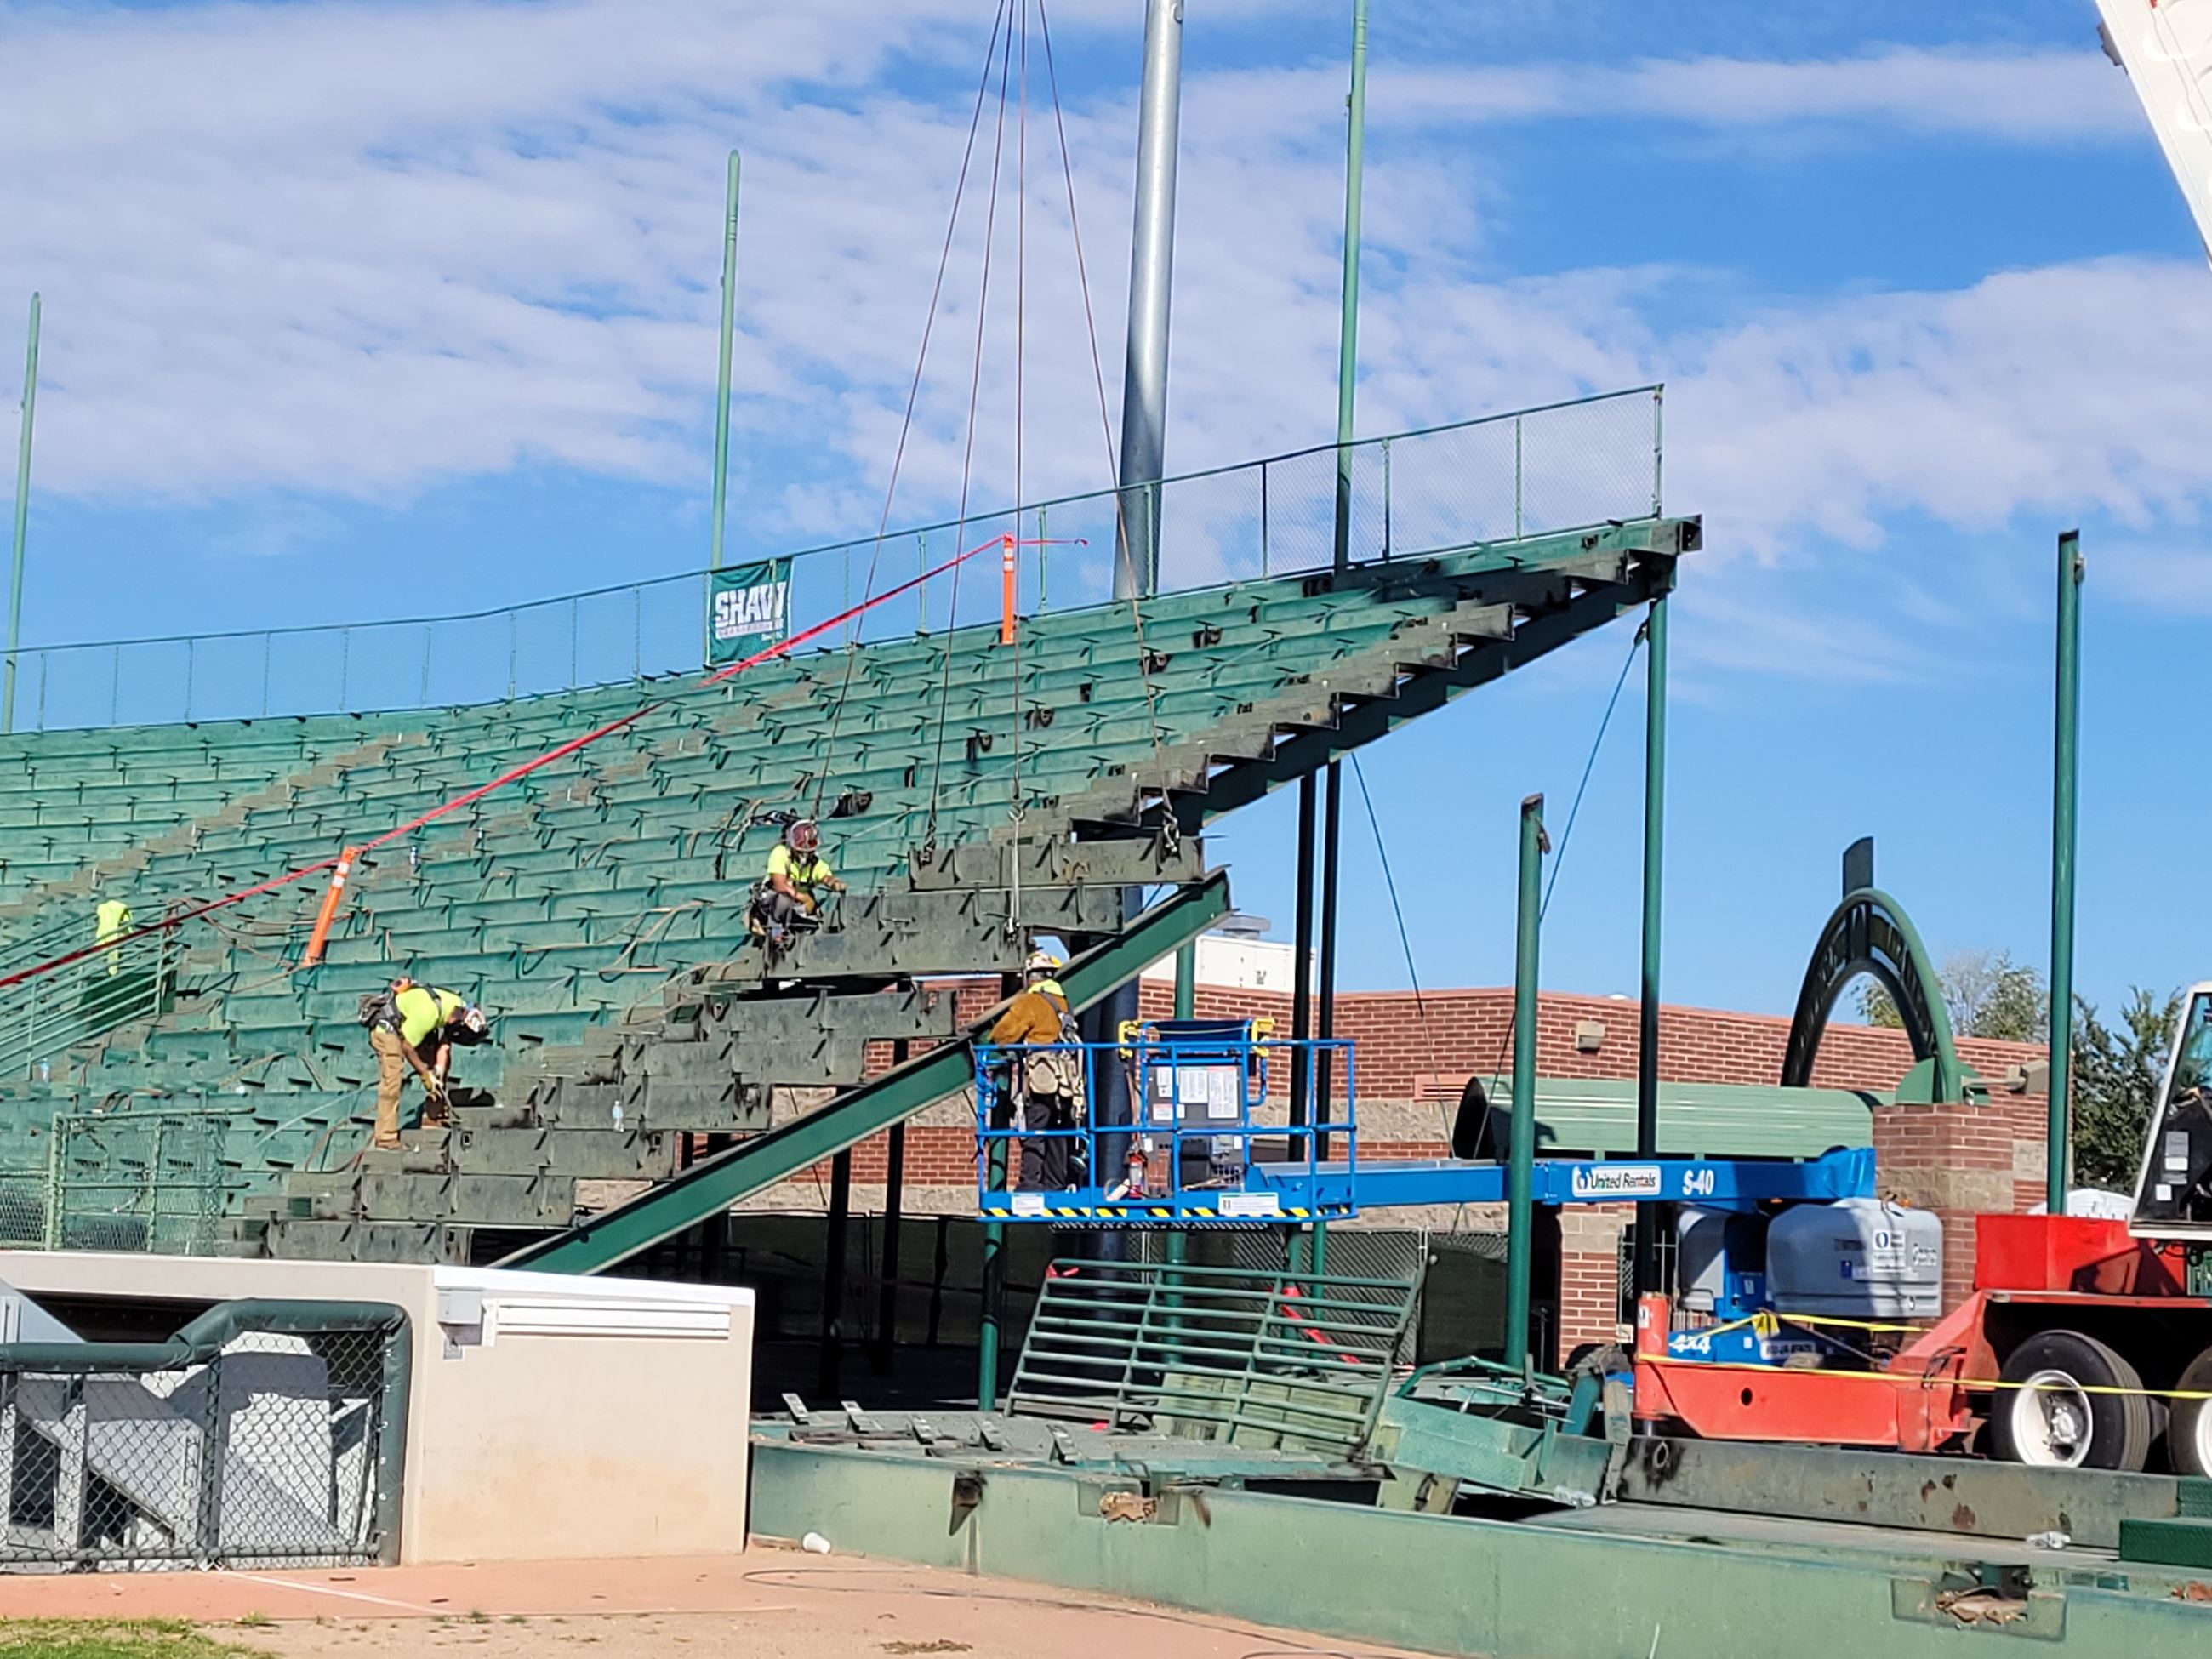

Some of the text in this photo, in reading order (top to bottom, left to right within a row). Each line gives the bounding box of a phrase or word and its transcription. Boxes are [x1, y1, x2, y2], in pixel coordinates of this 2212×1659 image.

[715, 582, 786, 628] SHAW
[1591, 1172, 1656, 1189] United Rentals
